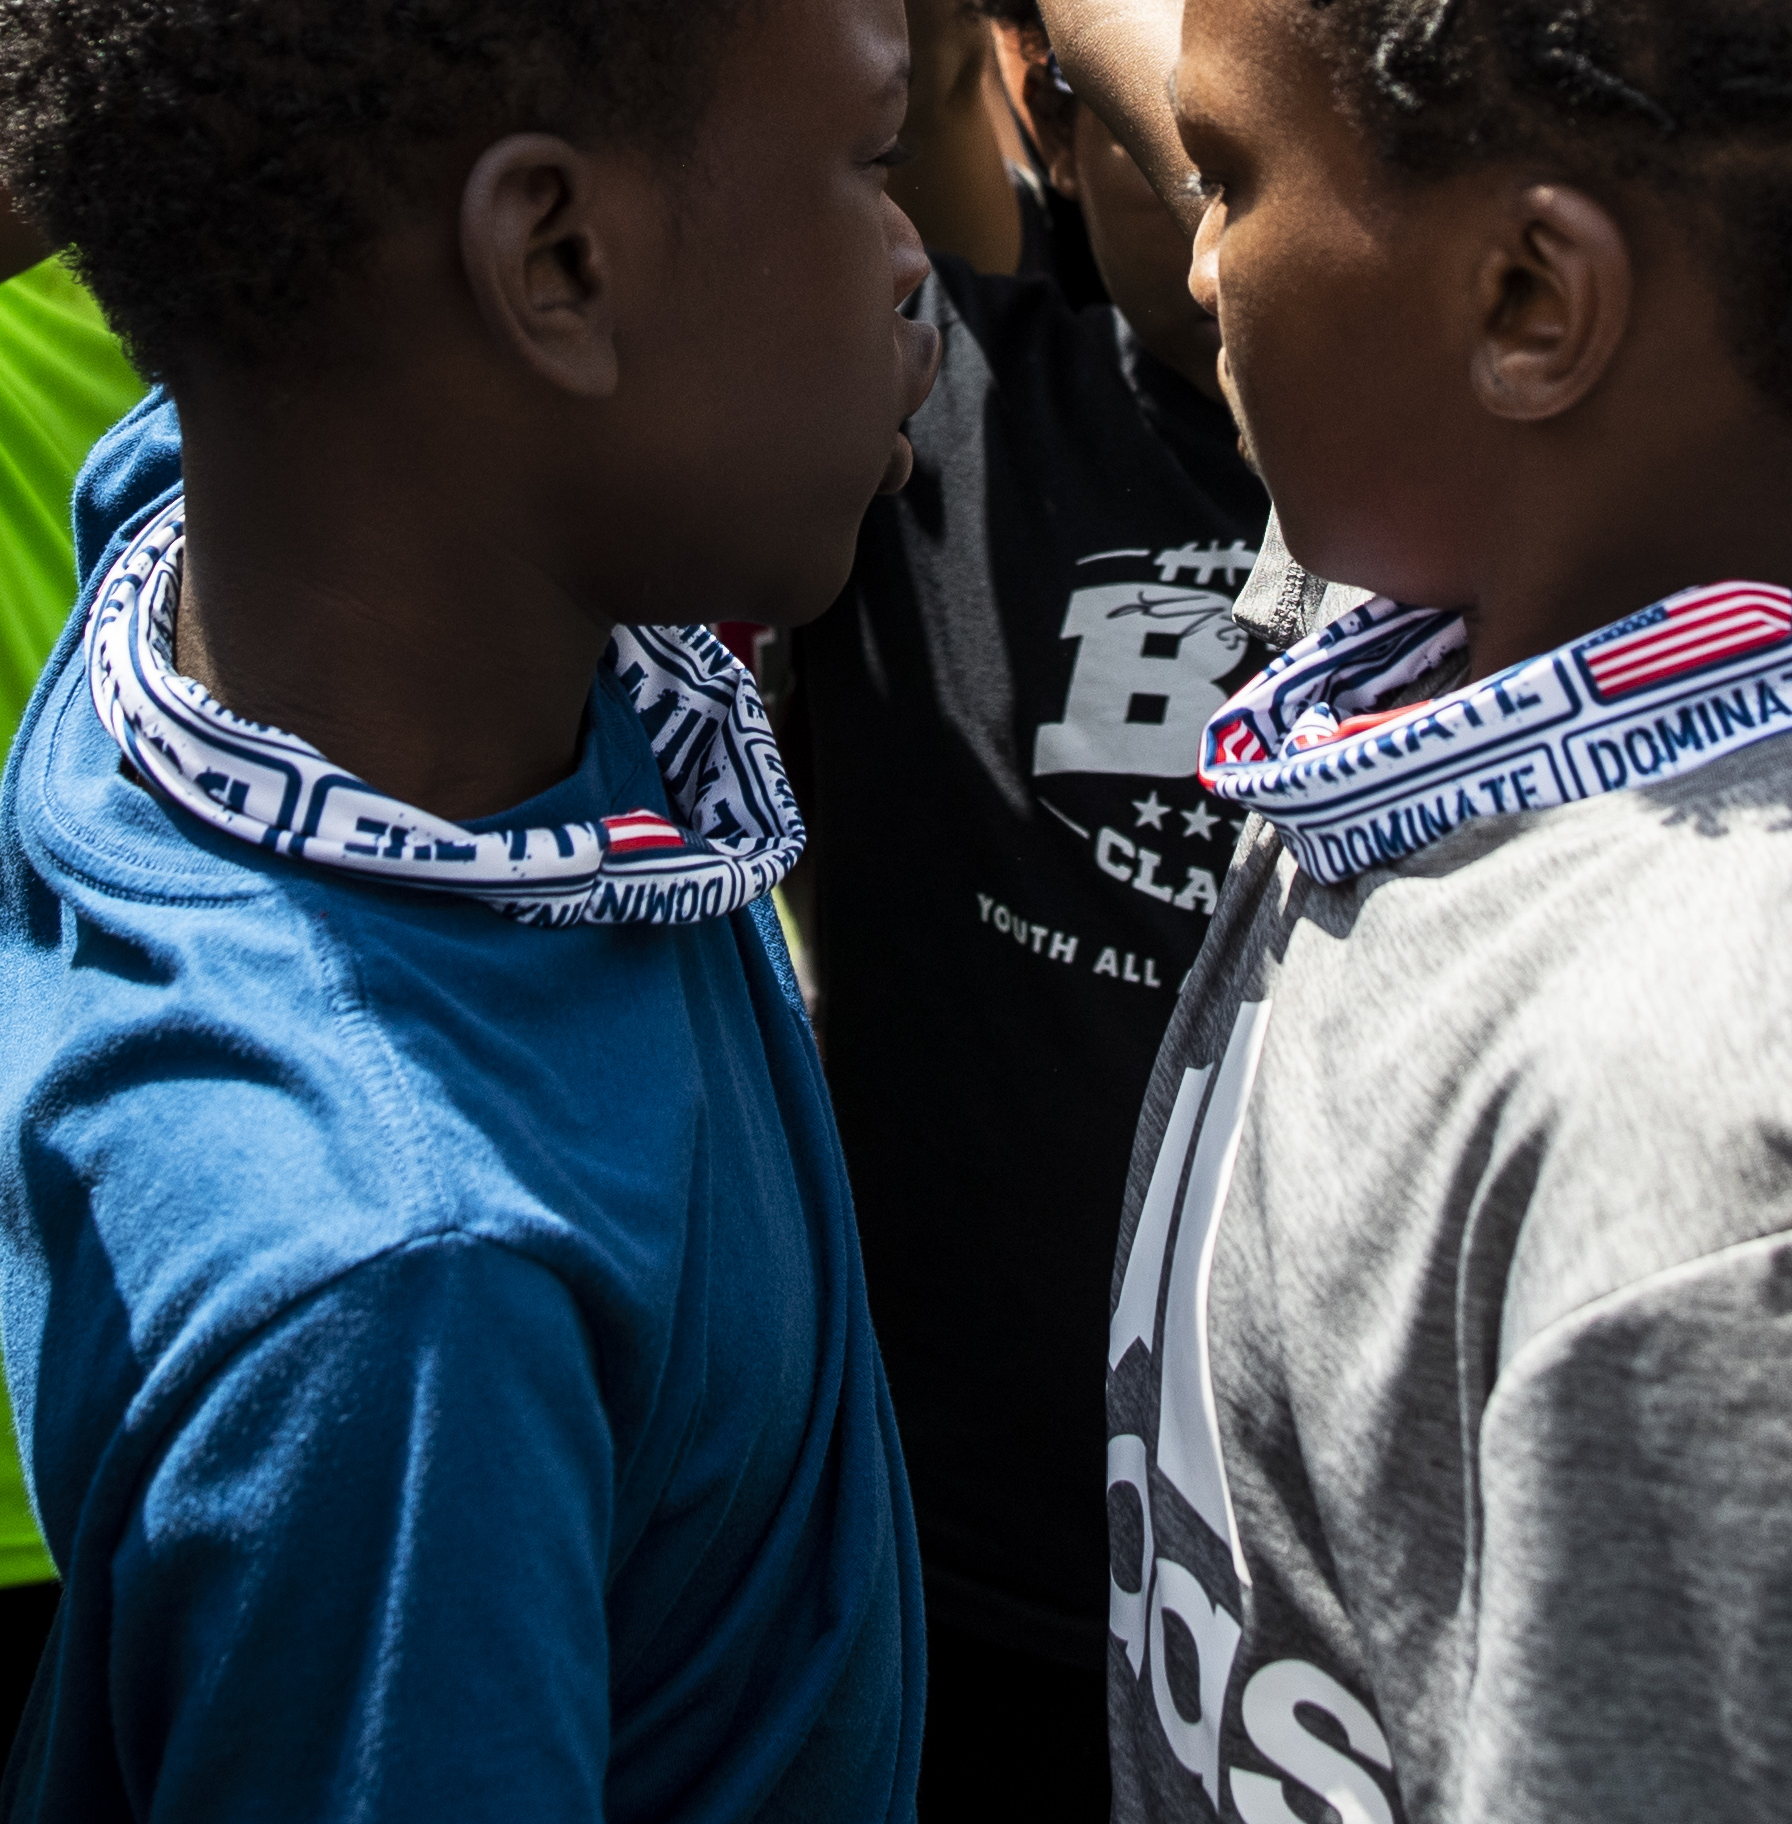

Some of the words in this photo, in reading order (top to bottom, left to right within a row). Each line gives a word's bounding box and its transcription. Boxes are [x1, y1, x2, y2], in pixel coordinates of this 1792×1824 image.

[1319, 765, 1541, 877] DOMINATE
[976, 892, 1079, 965] YOUTH
[1092, 946, 1162, 989] ALL
